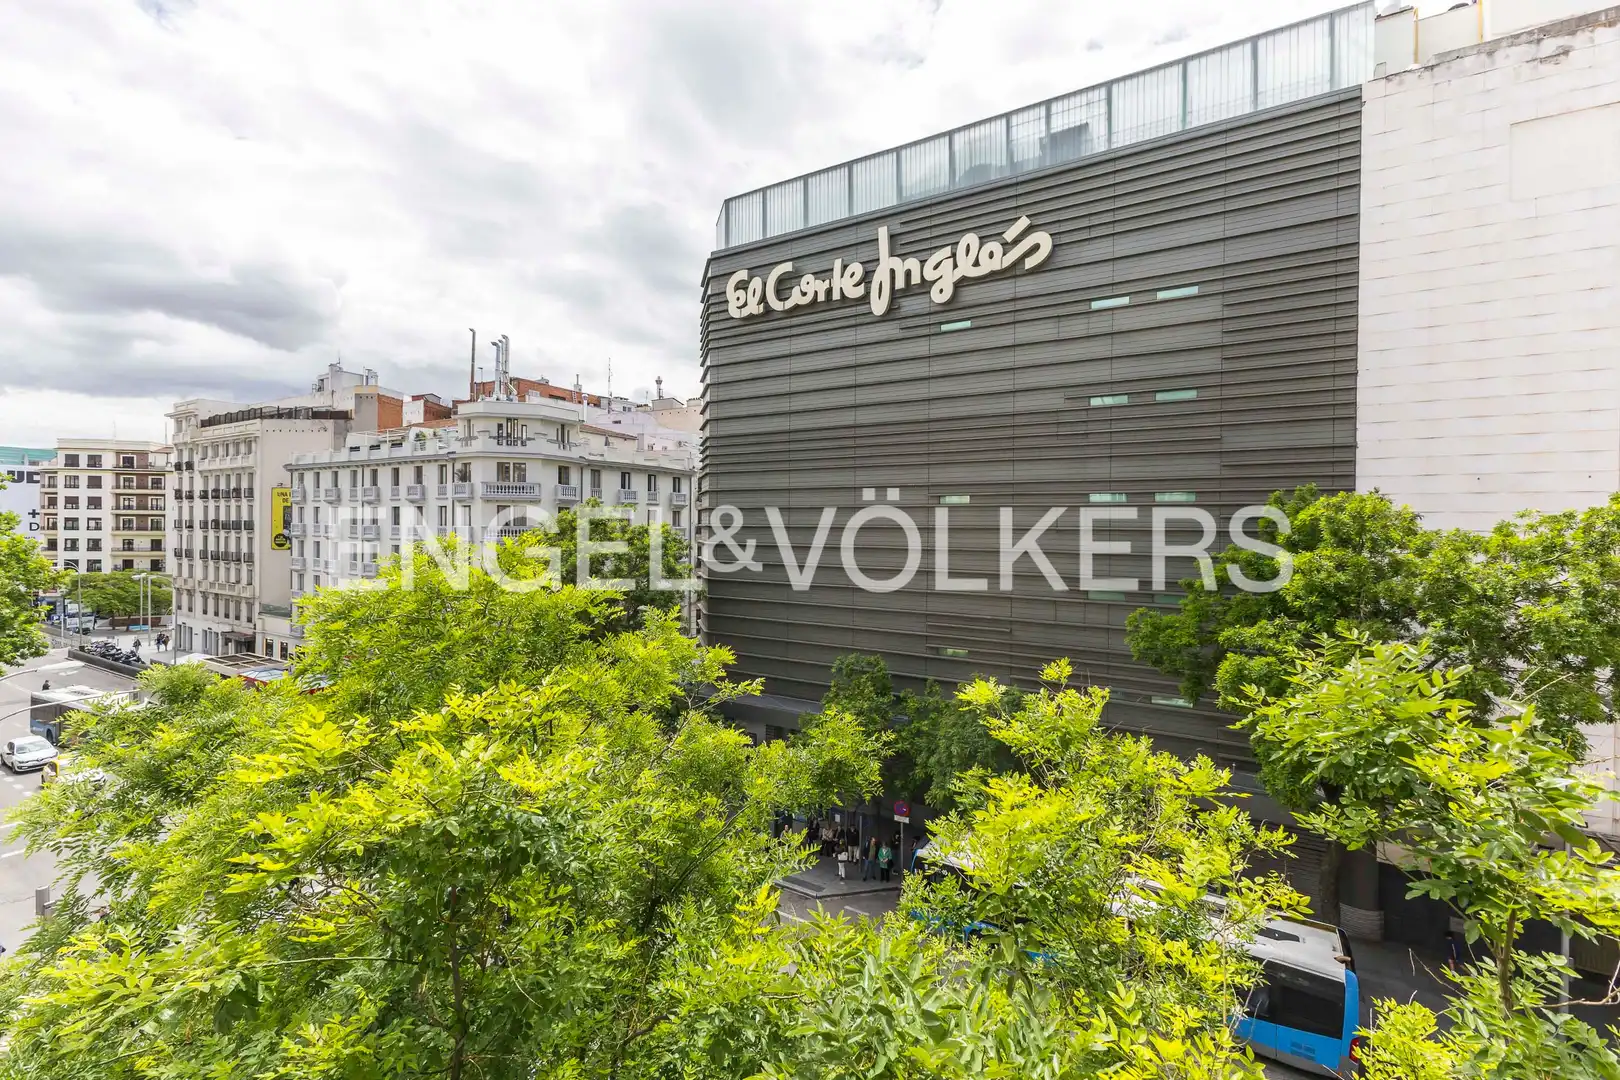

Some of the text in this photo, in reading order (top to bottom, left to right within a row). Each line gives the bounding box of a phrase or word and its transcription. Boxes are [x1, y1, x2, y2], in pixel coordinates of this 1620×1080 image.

[726, 215, 1053, 318] El Corte Inglés
